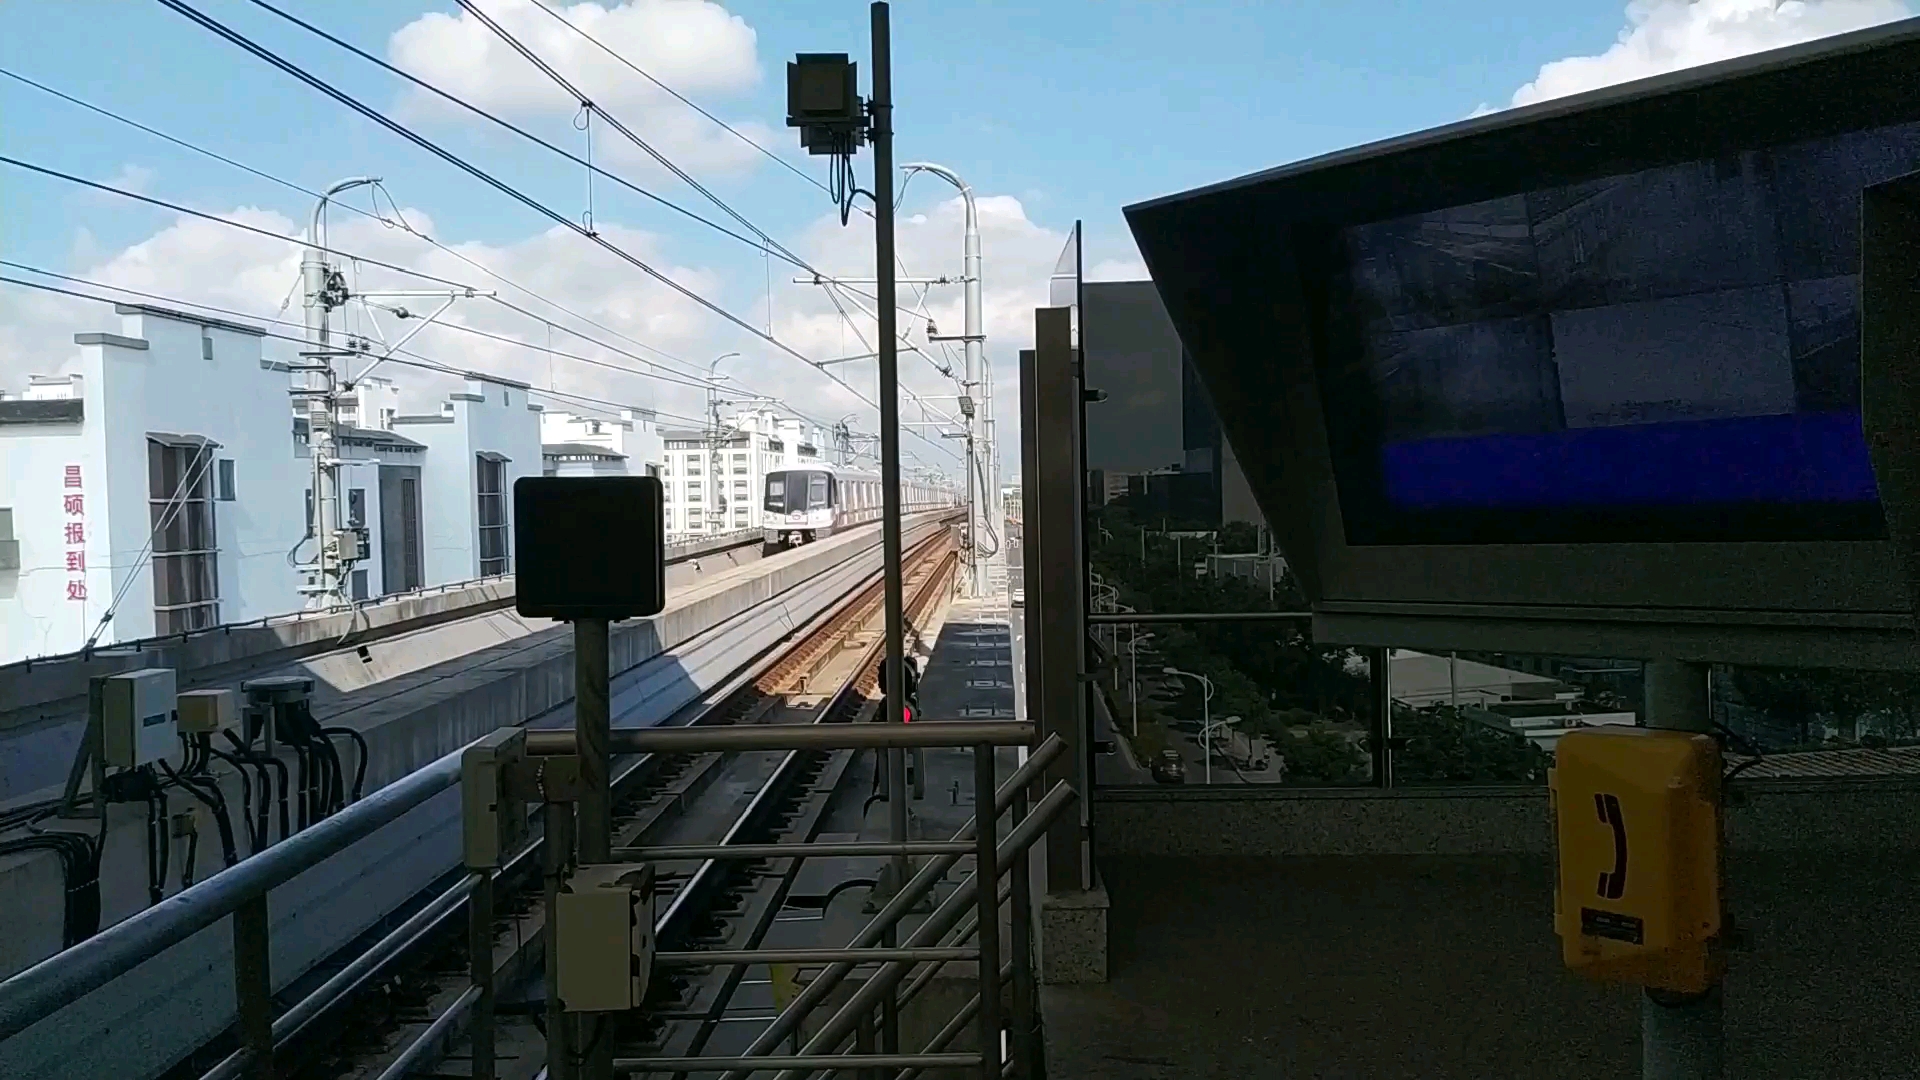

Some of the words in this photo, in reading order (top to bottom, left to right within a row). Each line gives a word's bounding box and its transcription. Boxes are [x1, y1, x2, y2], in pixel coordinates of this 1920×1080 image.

[64, 465, 87, 600] 昌硕报到处
